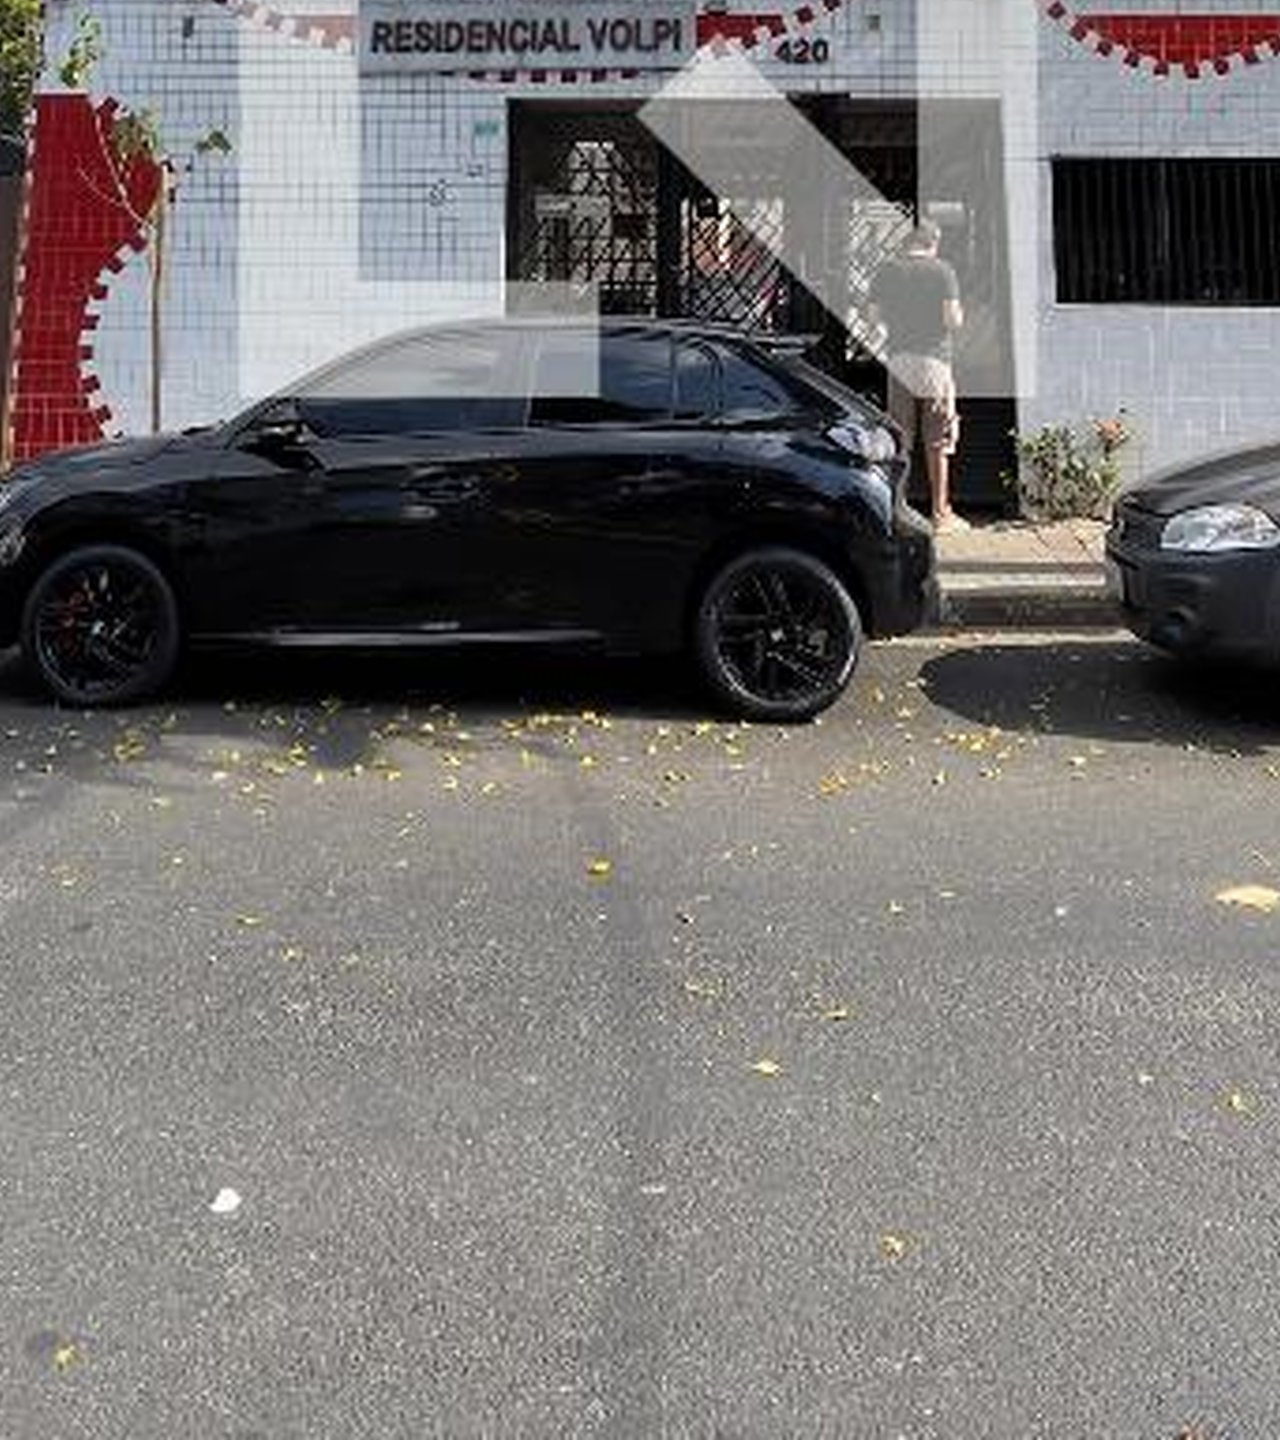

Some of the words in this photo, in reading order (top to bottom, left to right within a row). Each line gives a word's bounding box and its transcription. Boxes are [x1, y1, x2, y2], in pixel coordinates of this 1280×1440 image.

[372, 18, 580, 53] RESIDENCIAL
[586, 17, 681, 53] VOLPI
[776, 39, 829, 64] 420
